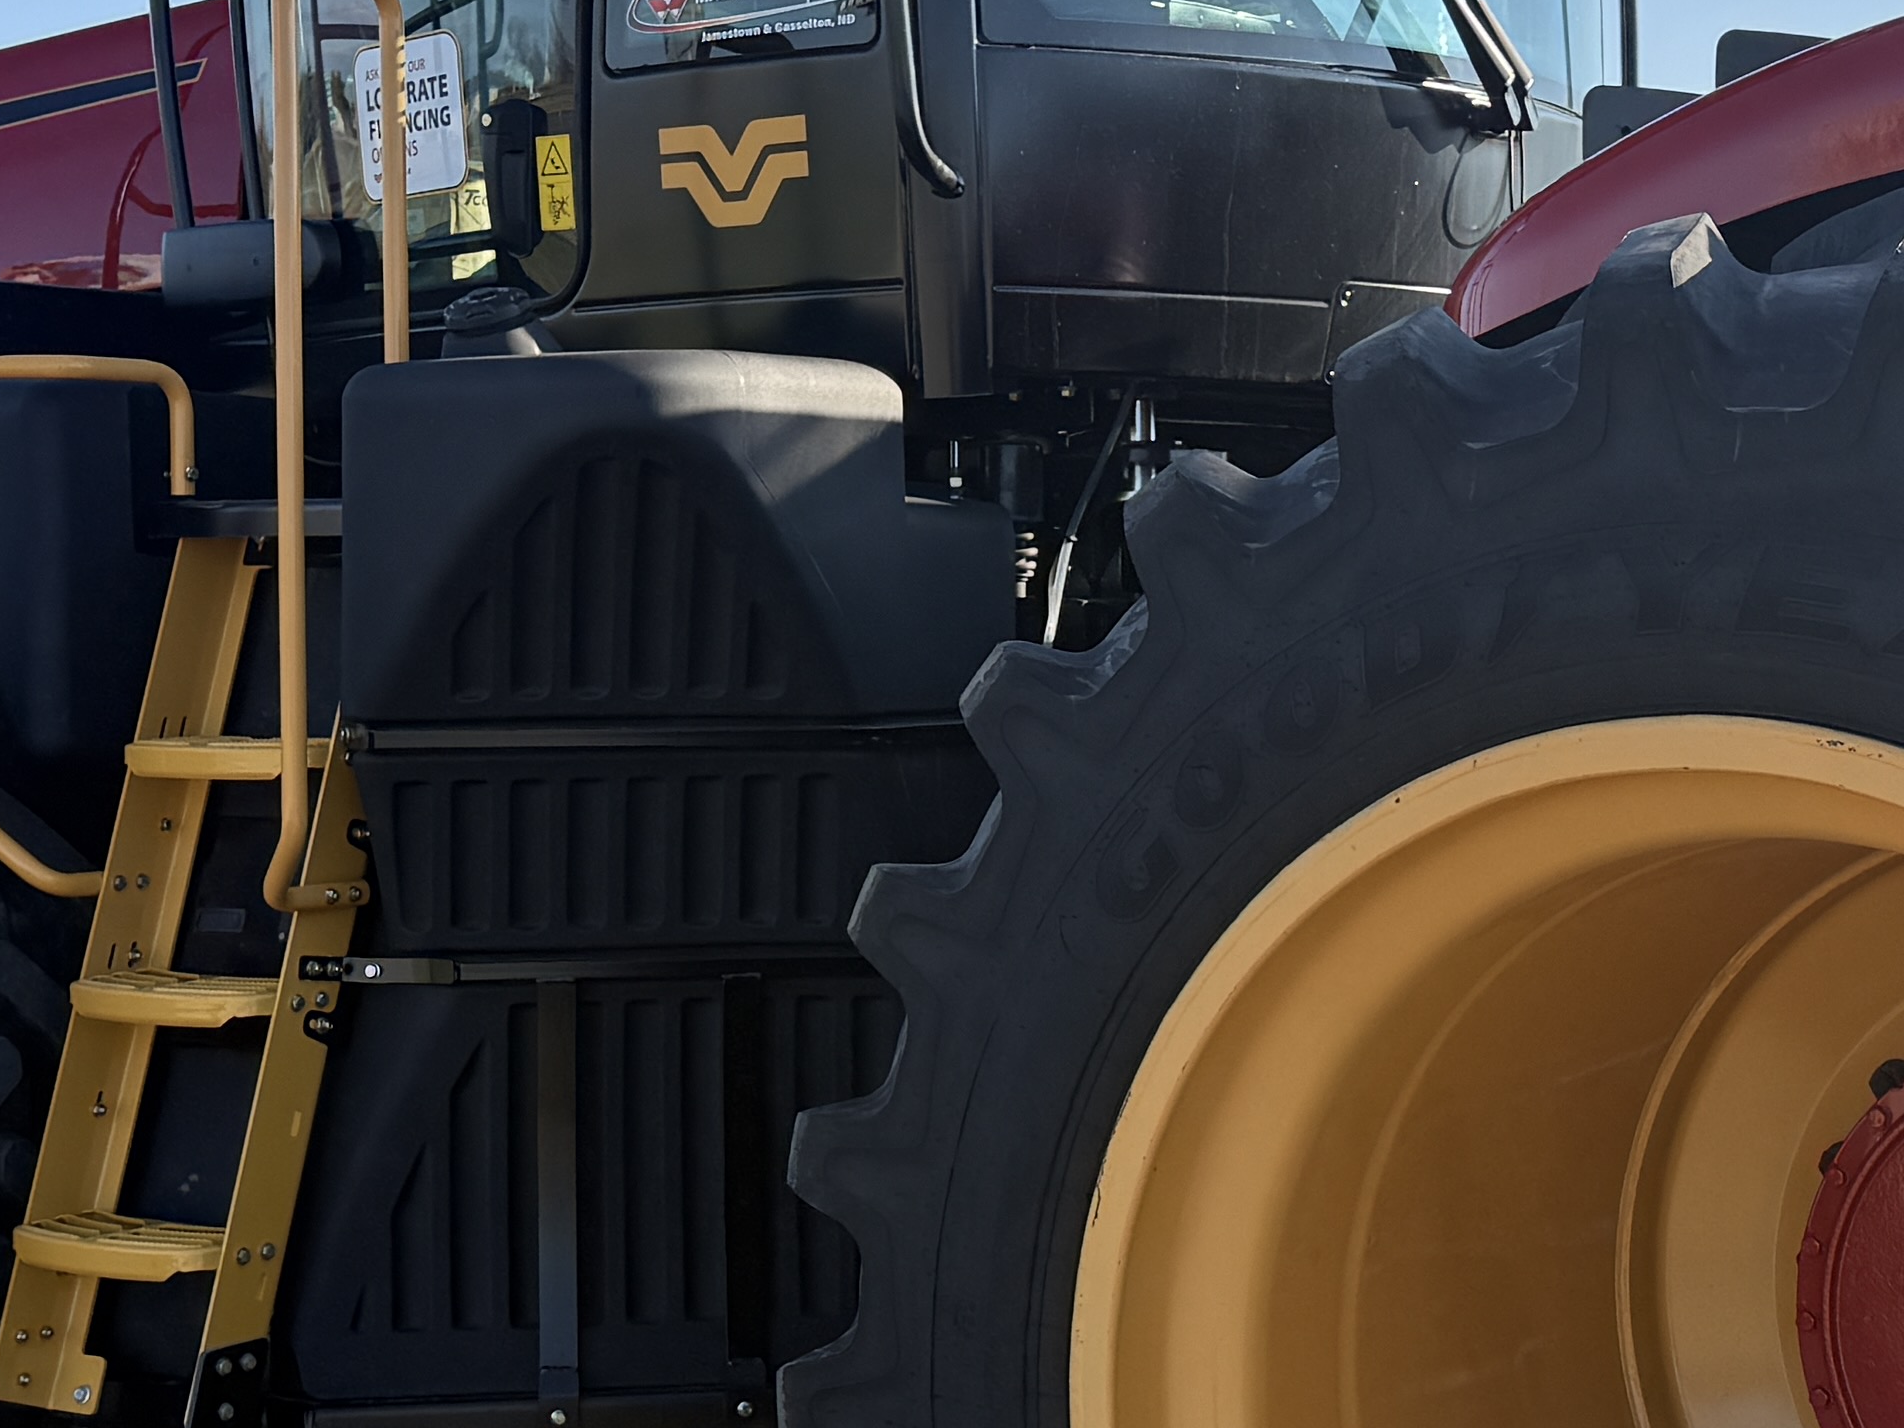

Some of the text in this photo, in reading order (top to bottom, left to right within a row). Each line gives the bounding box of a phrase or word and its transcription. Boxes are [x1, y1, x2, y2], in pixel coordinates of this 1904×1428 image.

[701, 26, 761, 43] Jamestown
[837, 13, 856, 27] ND
[407, 74, 449, 104] RATE
